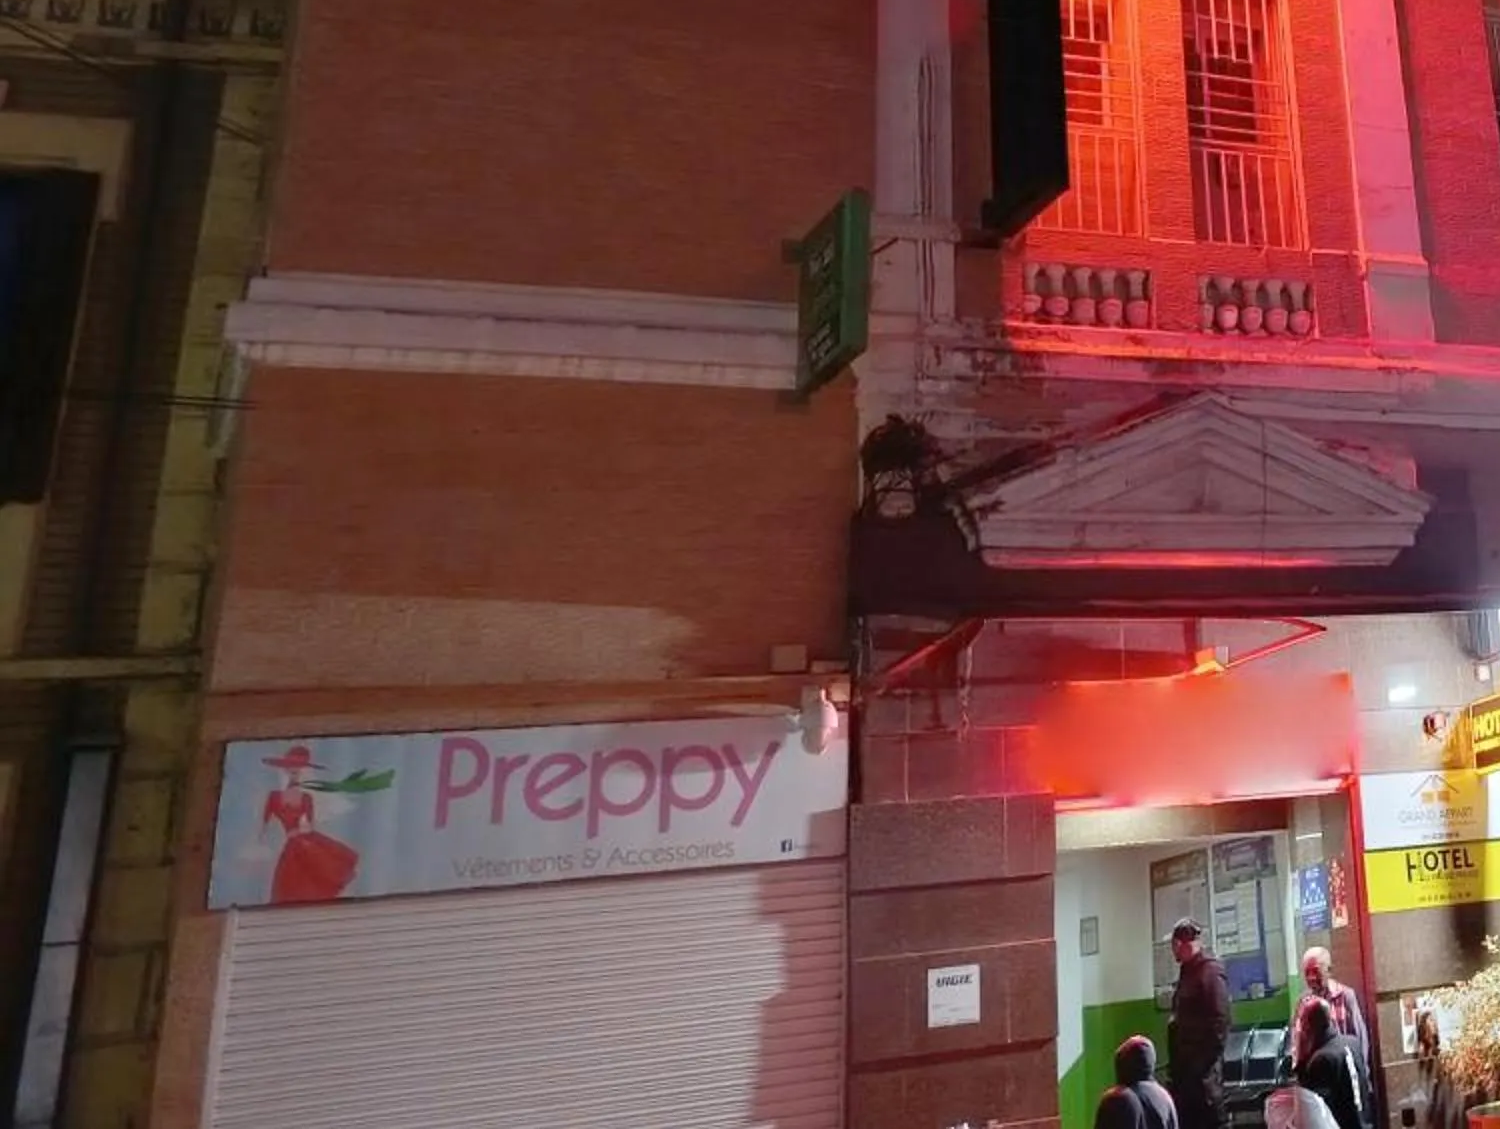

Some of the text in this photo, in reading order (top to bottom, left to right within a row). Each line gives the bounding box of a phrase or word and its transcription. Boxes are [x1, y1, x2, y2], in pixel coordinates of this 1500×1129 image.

[434, 736, 780, 839] Preppy
[606, 841, 735, 868] Accessoires
[1405, 847, 1475, 883] HOTEL
